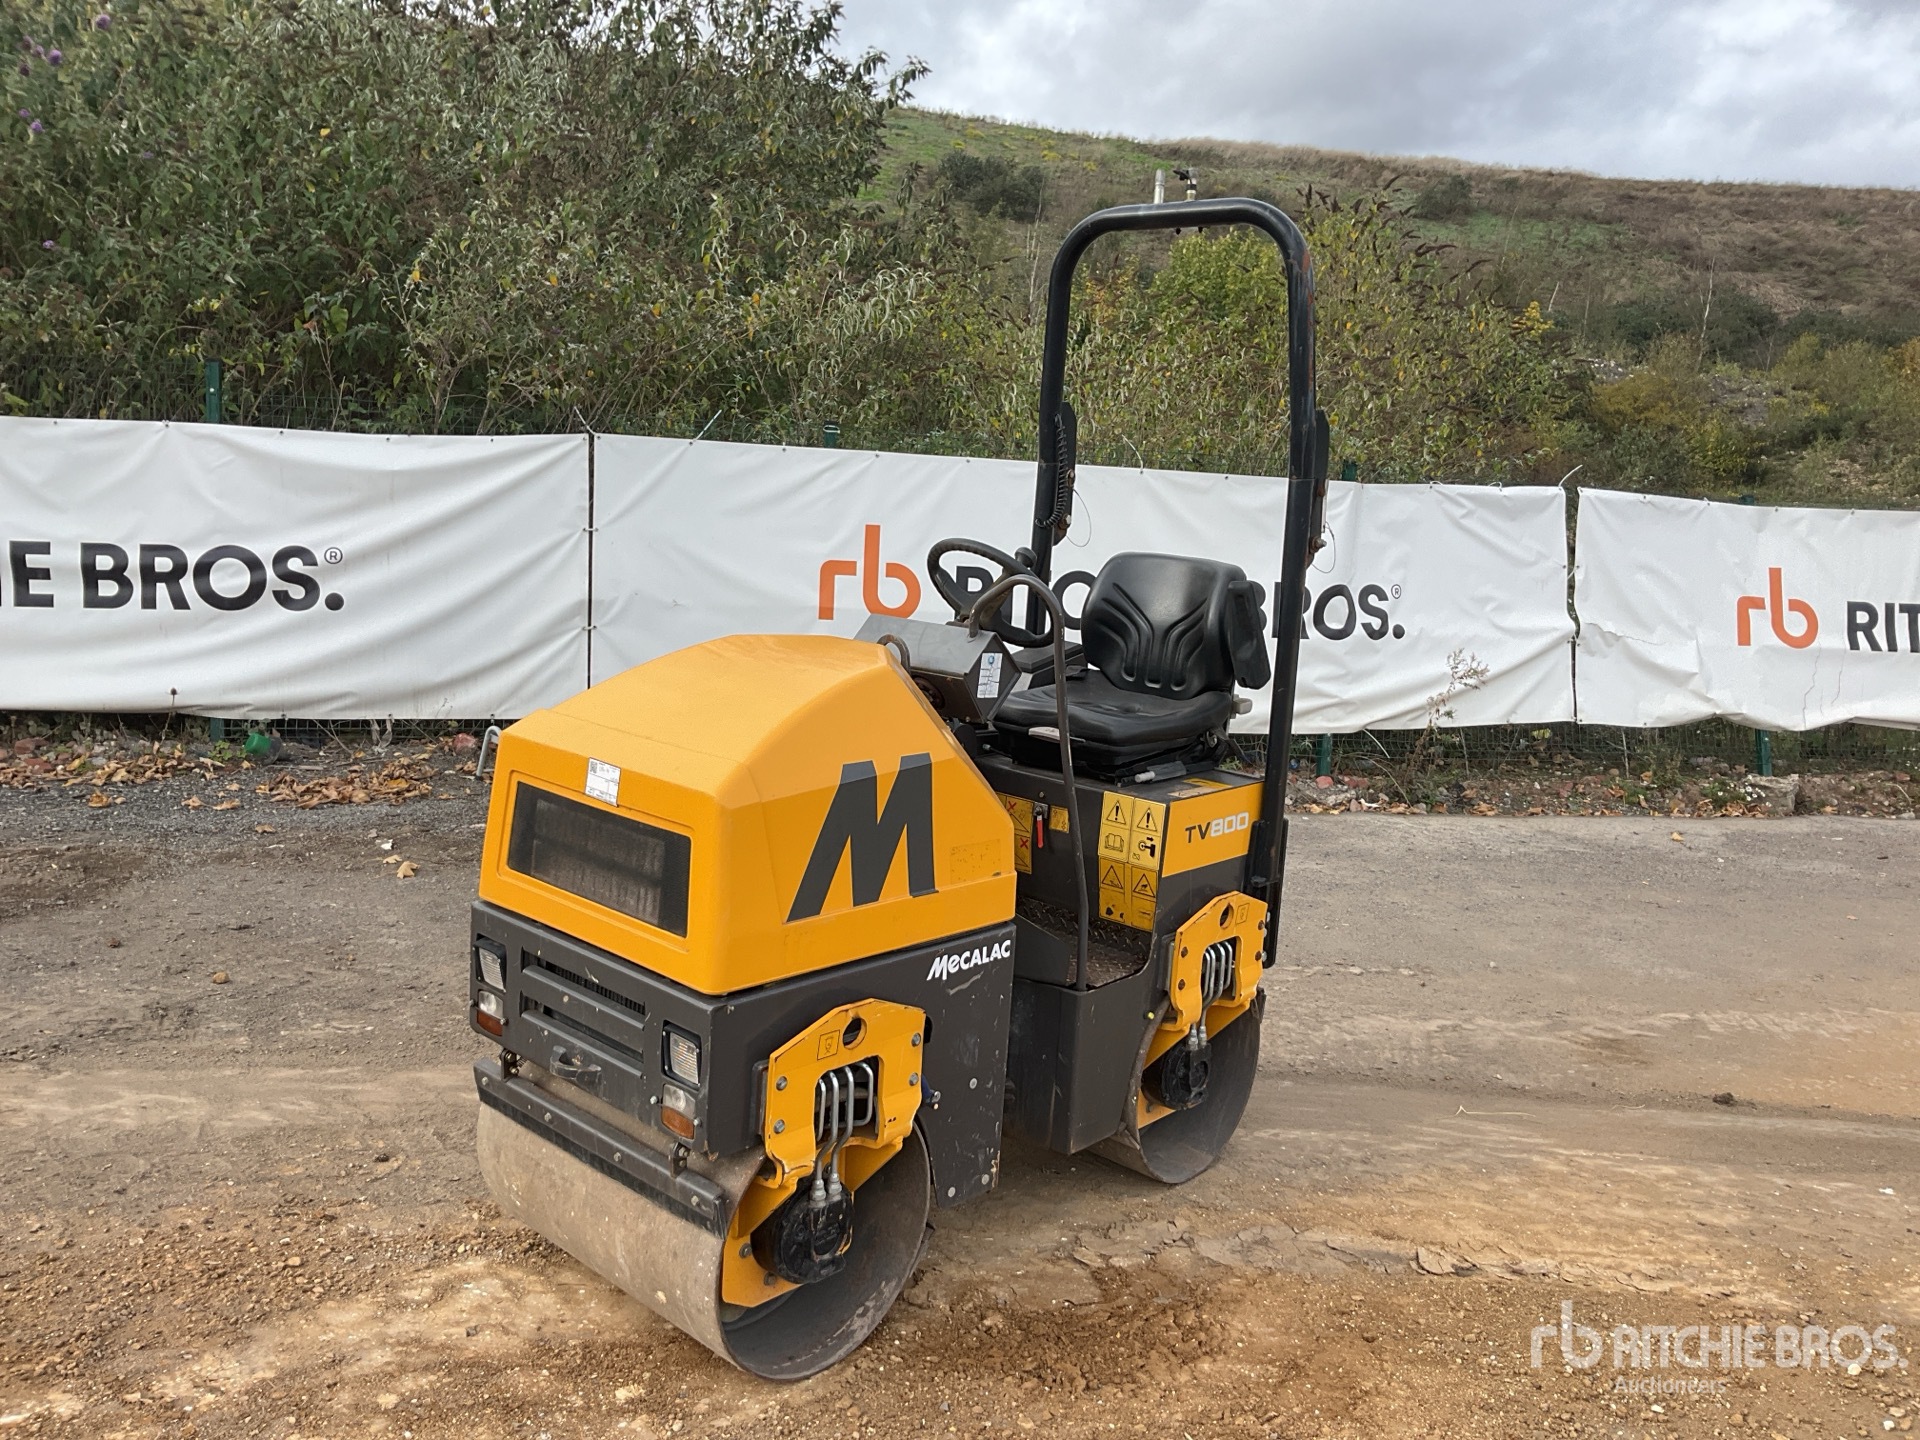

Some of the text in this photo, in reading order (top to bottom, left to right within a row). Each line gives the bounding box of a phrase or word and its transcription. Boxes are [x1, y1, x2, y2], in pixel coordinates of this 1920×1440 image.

[818, 524, 921, 620] rb
[1737, 567, 1920, 653] rb RIT
[786, 752, 939, 923] M
[1185, 811, 1249, 844] TV800
